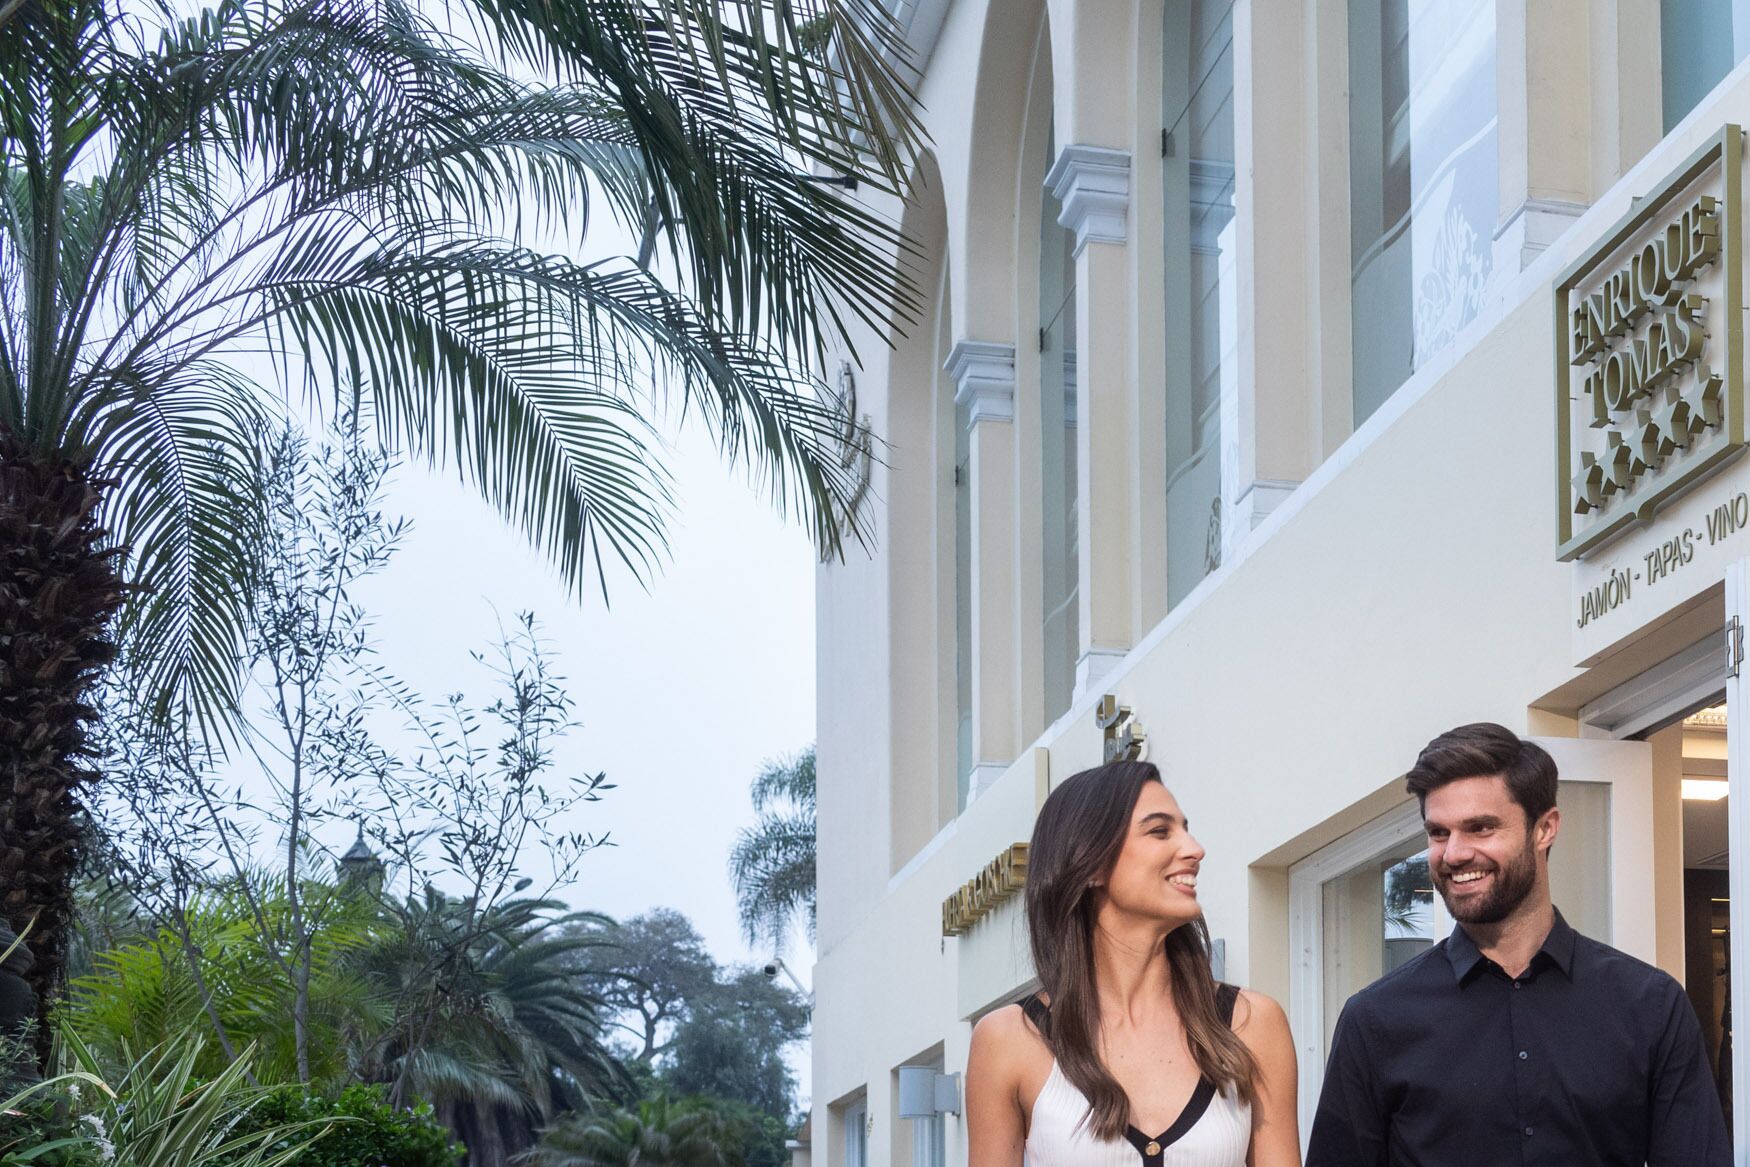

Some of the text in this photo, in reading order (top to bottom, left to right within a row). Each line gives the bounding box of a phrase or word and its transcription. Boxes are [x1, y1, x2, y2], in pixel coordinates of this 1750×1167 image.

[1571, 196, 1719, 366] ENRIQUE
[1584, 295, 1704, 428] TOMAS
[1577, 567, 1630, 629] JAMÓN
[1644, 528, 1694, 586] TAPAS
[1706, 491, 1750, 546] VINO
